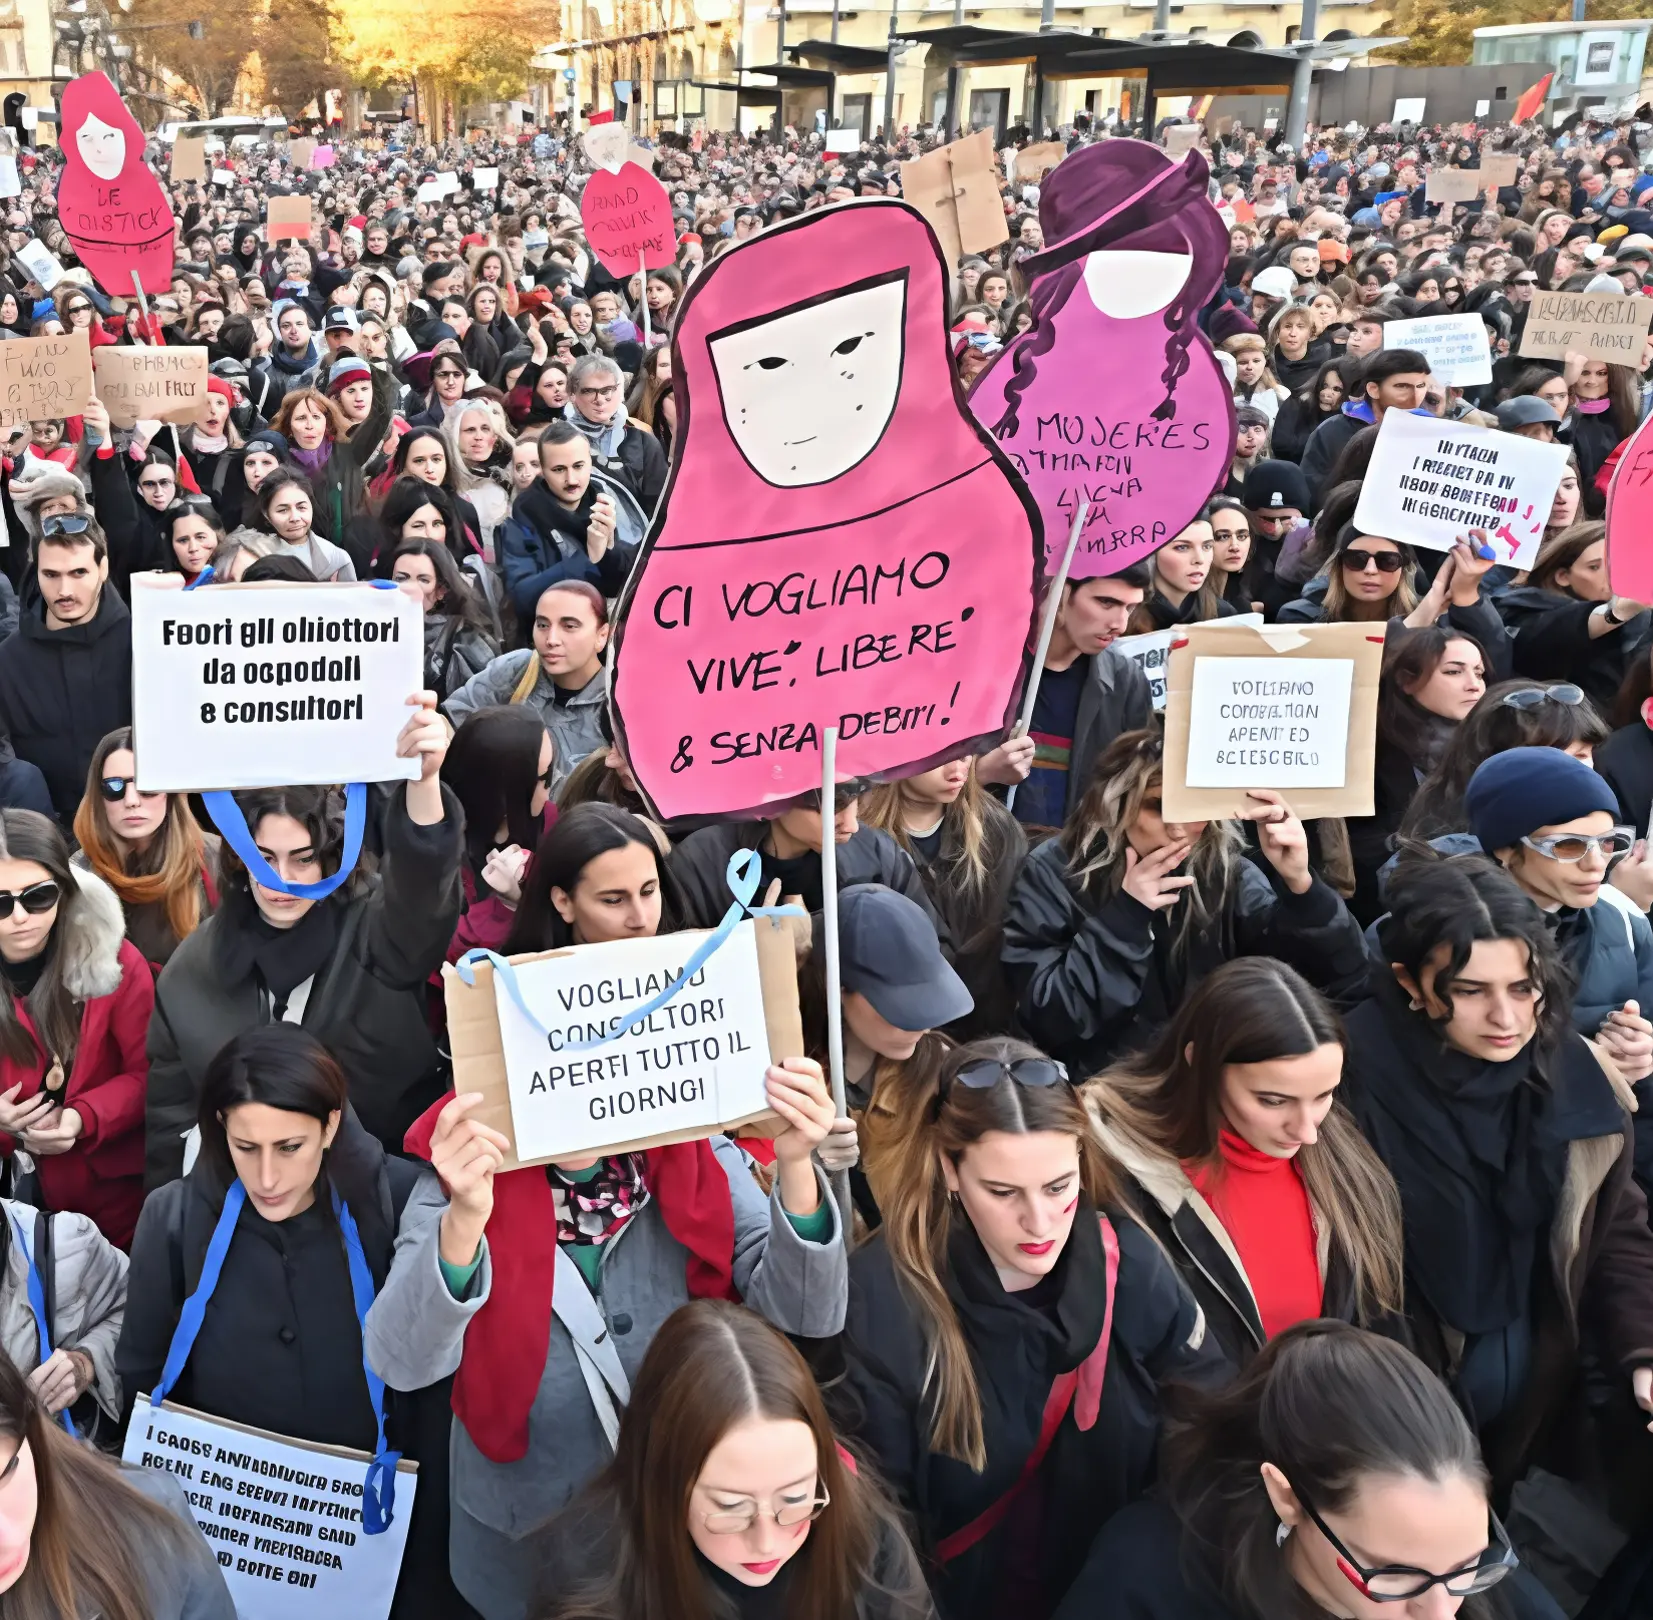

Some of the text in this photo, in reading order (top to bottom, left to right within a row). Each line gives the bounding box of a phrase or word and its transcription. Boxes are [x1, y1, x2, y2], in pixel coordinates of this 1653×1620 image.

[653, 551, 951, 629] CI VOGLIAMO
[670, 736, 694, 773] &
[710, 722, 819, 765] SENZA
[636, 1036, 720, 1072] TUTTO
[727, 1031, 751, 1054] IL
